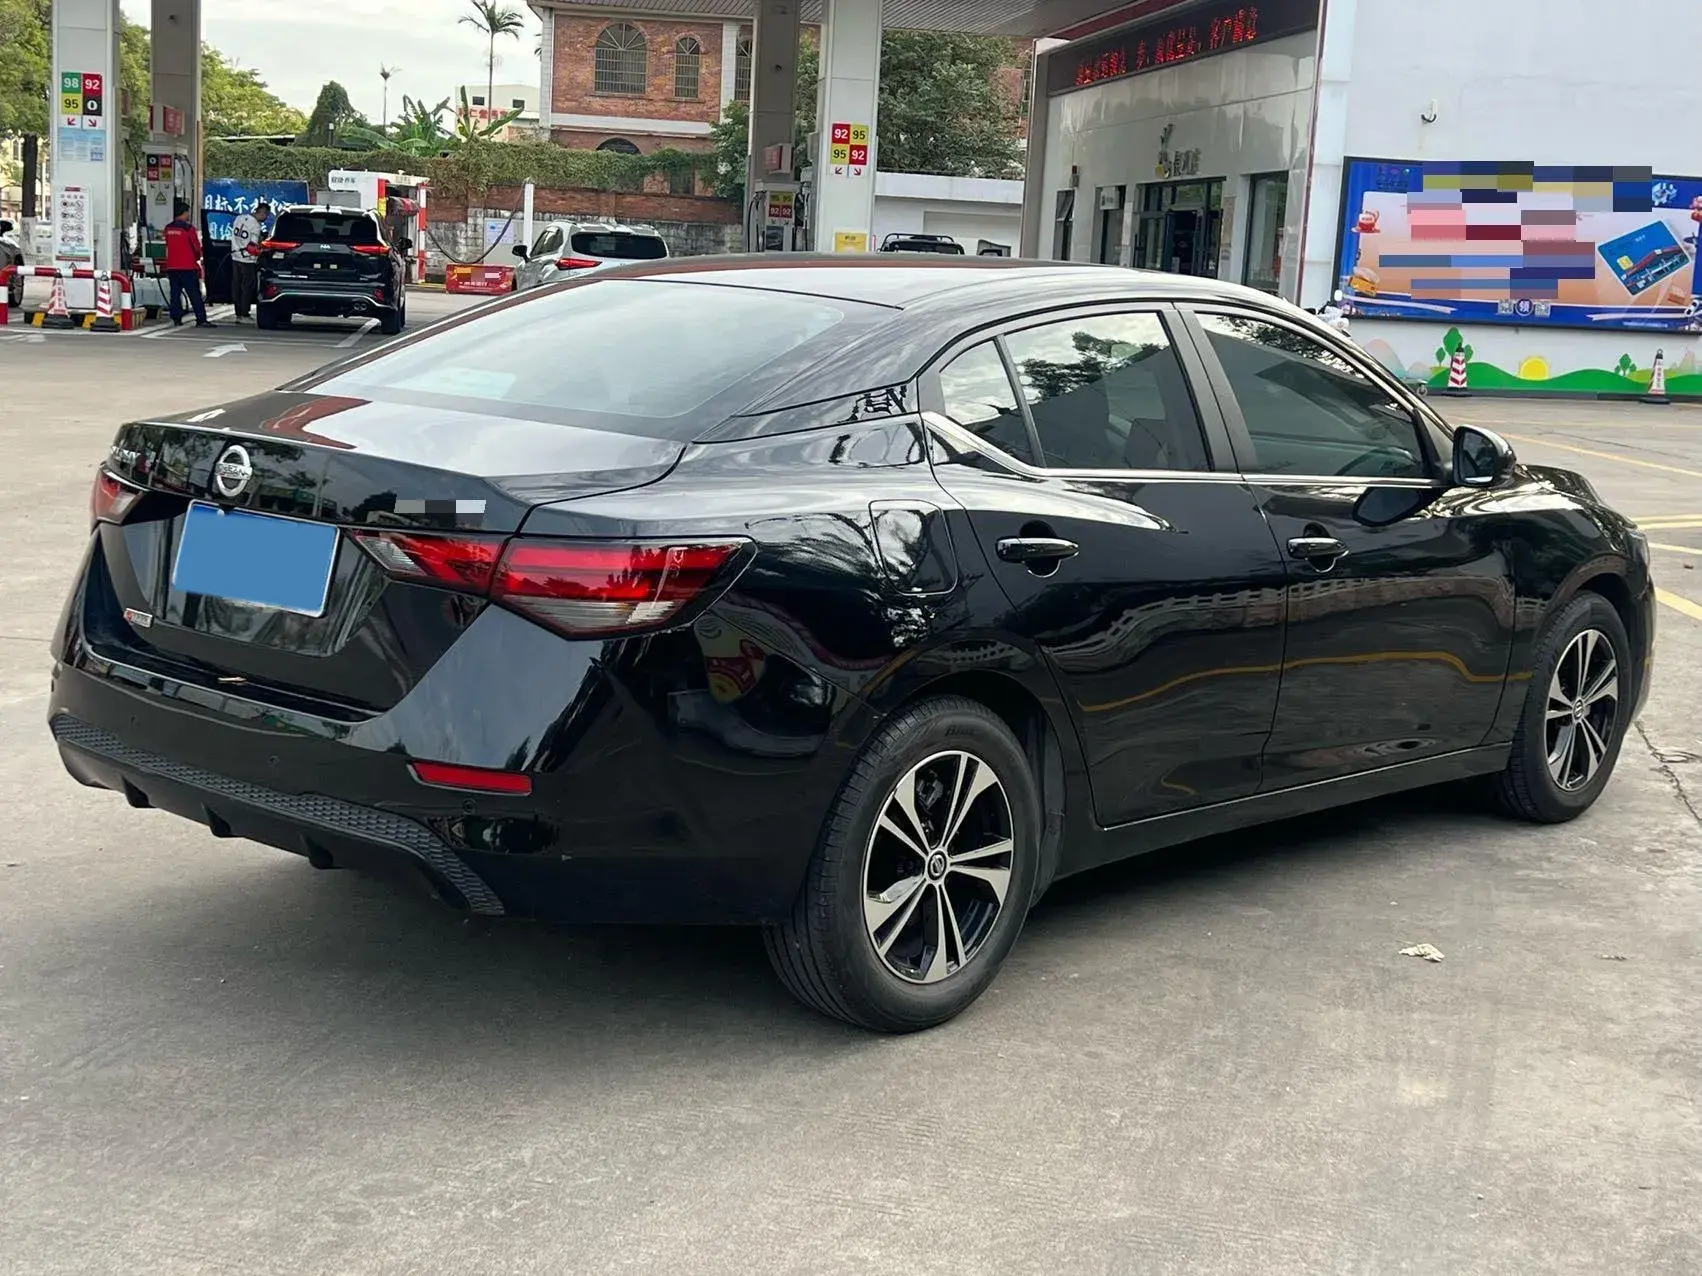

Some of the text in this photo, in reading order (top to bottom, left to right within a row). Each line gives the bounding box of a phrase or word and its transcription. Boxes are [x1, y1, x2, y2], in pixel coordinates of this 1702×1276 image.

[63, 77, 100, 90] 98 92
[64, 98, 98, 111] 95 0
[834, 129, 866, 140] 92 95
[833, 149, 865, 160] 95 92
